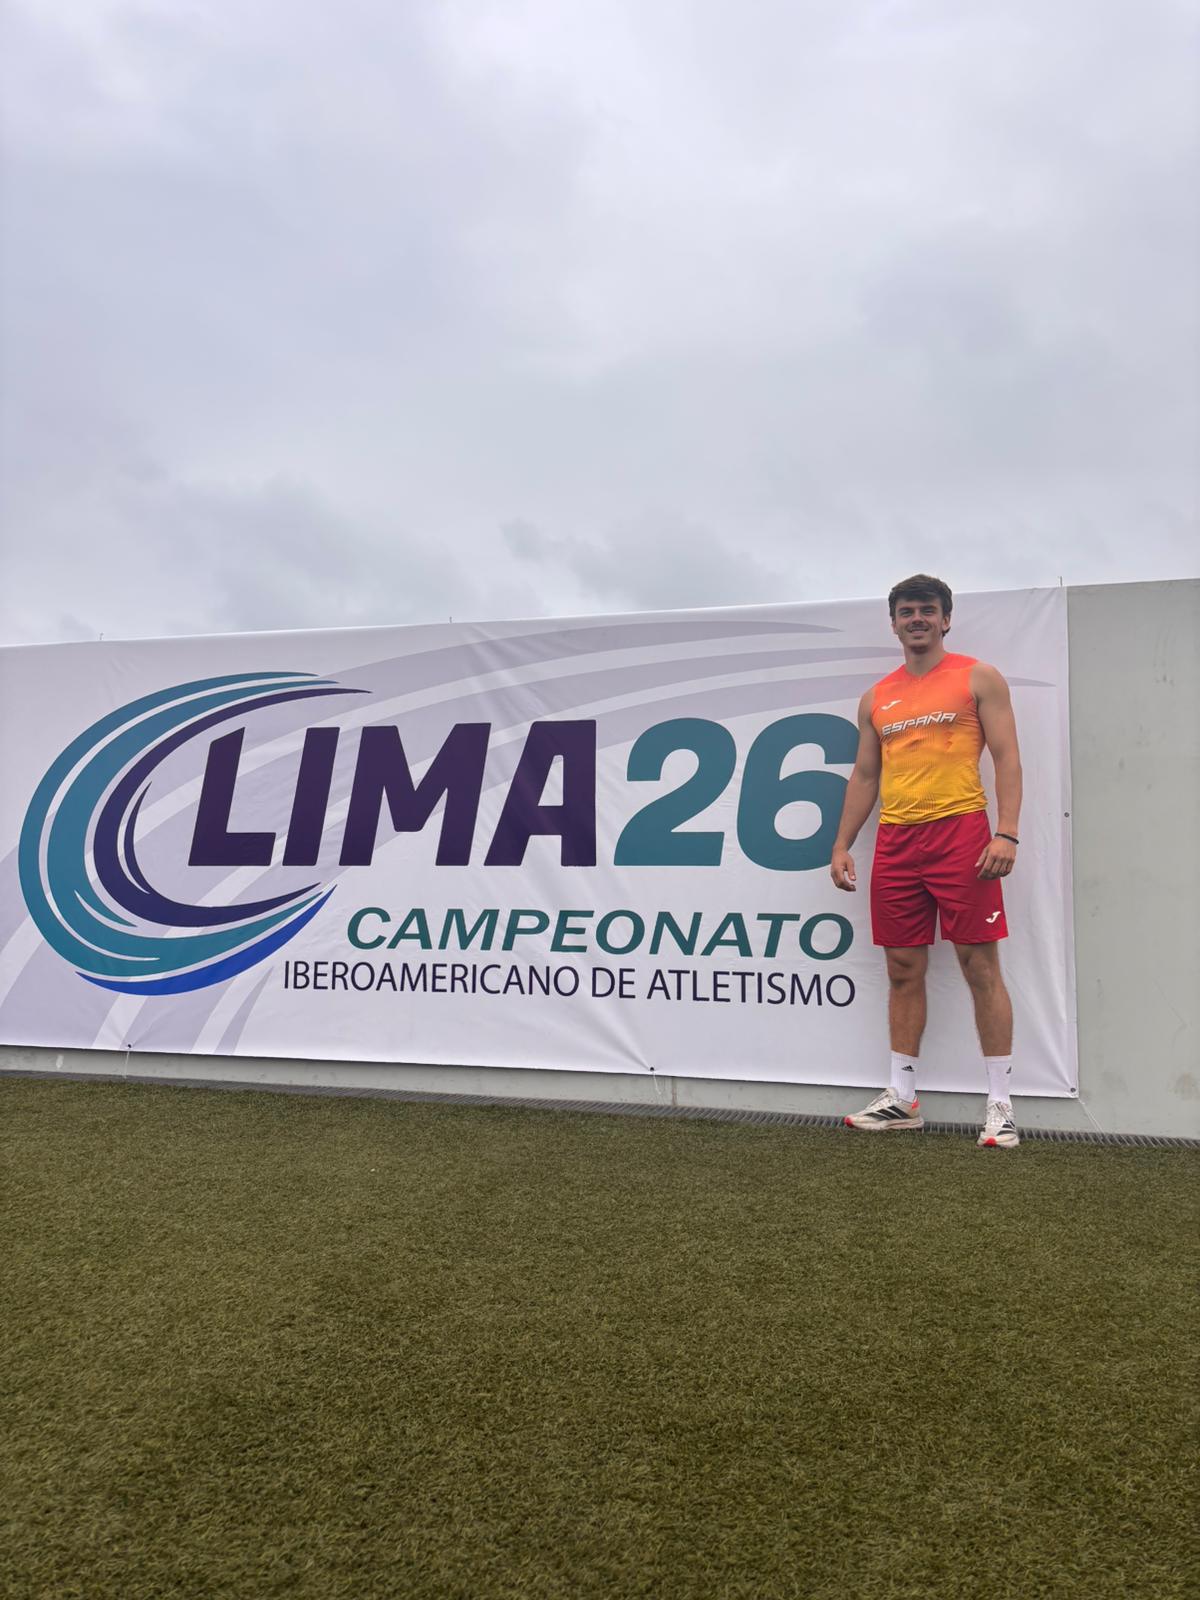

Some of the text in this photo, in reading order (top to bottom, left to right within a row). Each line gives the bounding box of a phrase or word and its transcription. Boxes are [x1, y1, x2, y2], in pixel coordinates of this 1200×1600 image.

[881, 711, 957, 736] ESPAÑA
[347, 907, 853, 960] CAMPEONATO
[284, 961, 855, 1006] IBEROAMERICANO DE ATLETISMO
